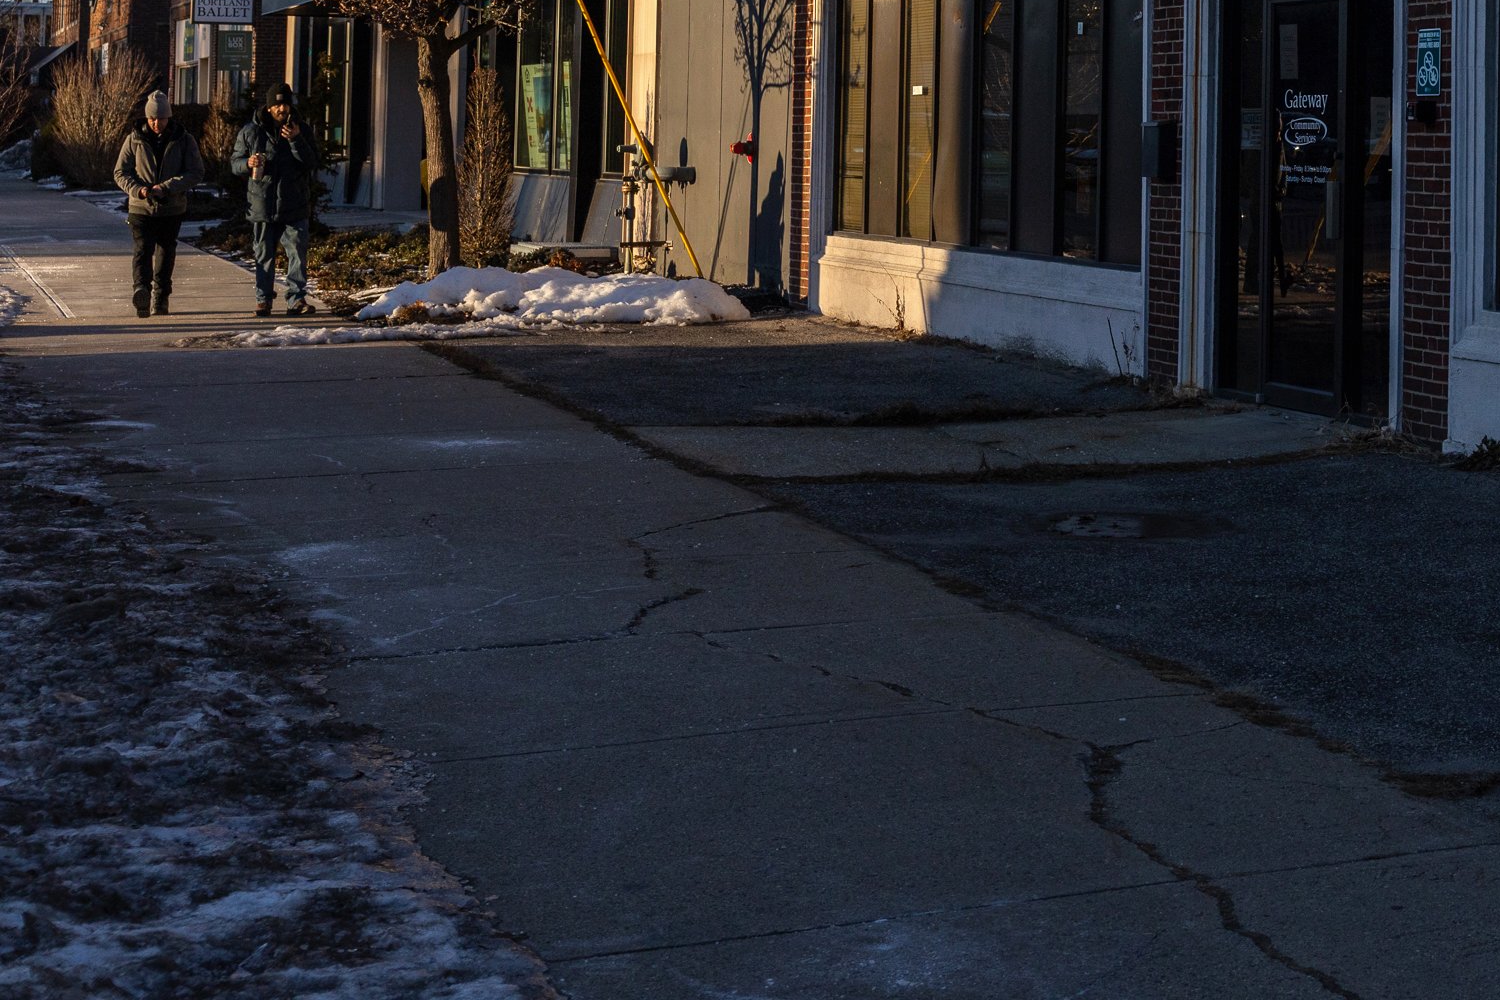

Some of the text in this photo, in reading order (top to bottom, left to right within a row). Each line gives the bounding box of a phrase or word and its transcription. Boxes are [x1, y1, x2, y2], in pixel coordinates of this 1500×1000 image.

[197, 7, 250, 18] BALLET
[1285, 88, 1328, 115] Gateway
[1290, 119, 1321, 133] Community
[1295, 132, 1316, 143] Services
